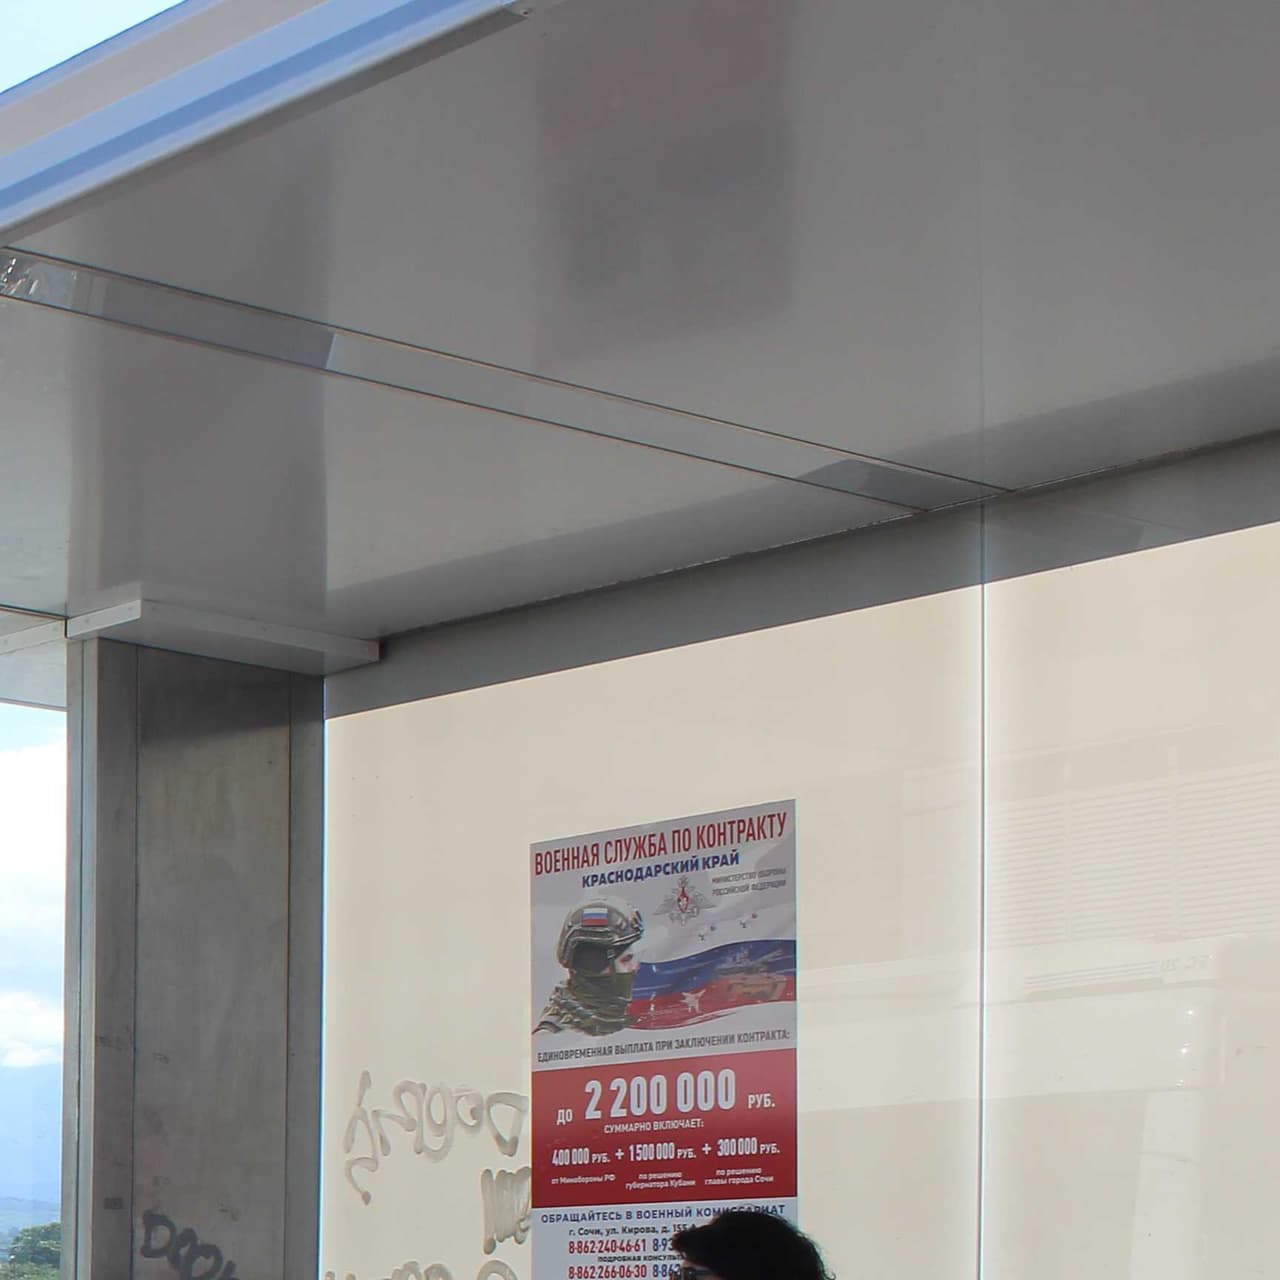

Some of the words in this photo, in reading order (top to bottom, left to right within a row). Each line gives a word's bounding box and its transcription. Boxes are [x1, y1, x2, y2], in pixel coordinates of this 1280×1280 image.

[535, 842, 600, 876] ВОЕННАЯ
[604, 831, 666, 864] СЛУЖБА
[671, 828, 692, 851] ПО
[696, 812, 787, 848] КОНТРАКТУ
[582, 855, 699, 889] КРАСНОДАРСКИЙ
[702, 849, 740, 870] КРАЙ
[537, 1045, 613, 1063] ЕДИНОВРЕМЕННАЯ
[615, 1041, 654, 1055] ВЫПЛАТА
[655, 1040, 672, 1051] ПРИ
[737, 1029, 790, 1044] КОНТРАКТА:
[584, 1080, 602, 1120] 2
[610, 1074, 667, 1118] 200
[676, 1068, 736, 1113] 000
[748, 1093, 776, 1109] РУБ.
[604, 1121, 652, 1134] СУММАРНО
[654, 1118, 704, 1131] ВКЛЮЧАЕТ:
[591, 1152, 610, 1164] РУБ.
[676, 1148, 696, 1159] РУБ.
[760, 1143, 780, 1154] РУБ.
[541, 1209, 622, 1224] ОБРАЩАЙТЕСЬ
[625, 1211, 633, 1220] В
[636, 1205, 692, 1220] ВОЕННЫЙ
[578, 1226, 603, 1237] Сочи,
[568, 1238, 647, 1254] 8-862-240-46-61
[568, 1264, 647, 1280] 8-862-266-06-30
